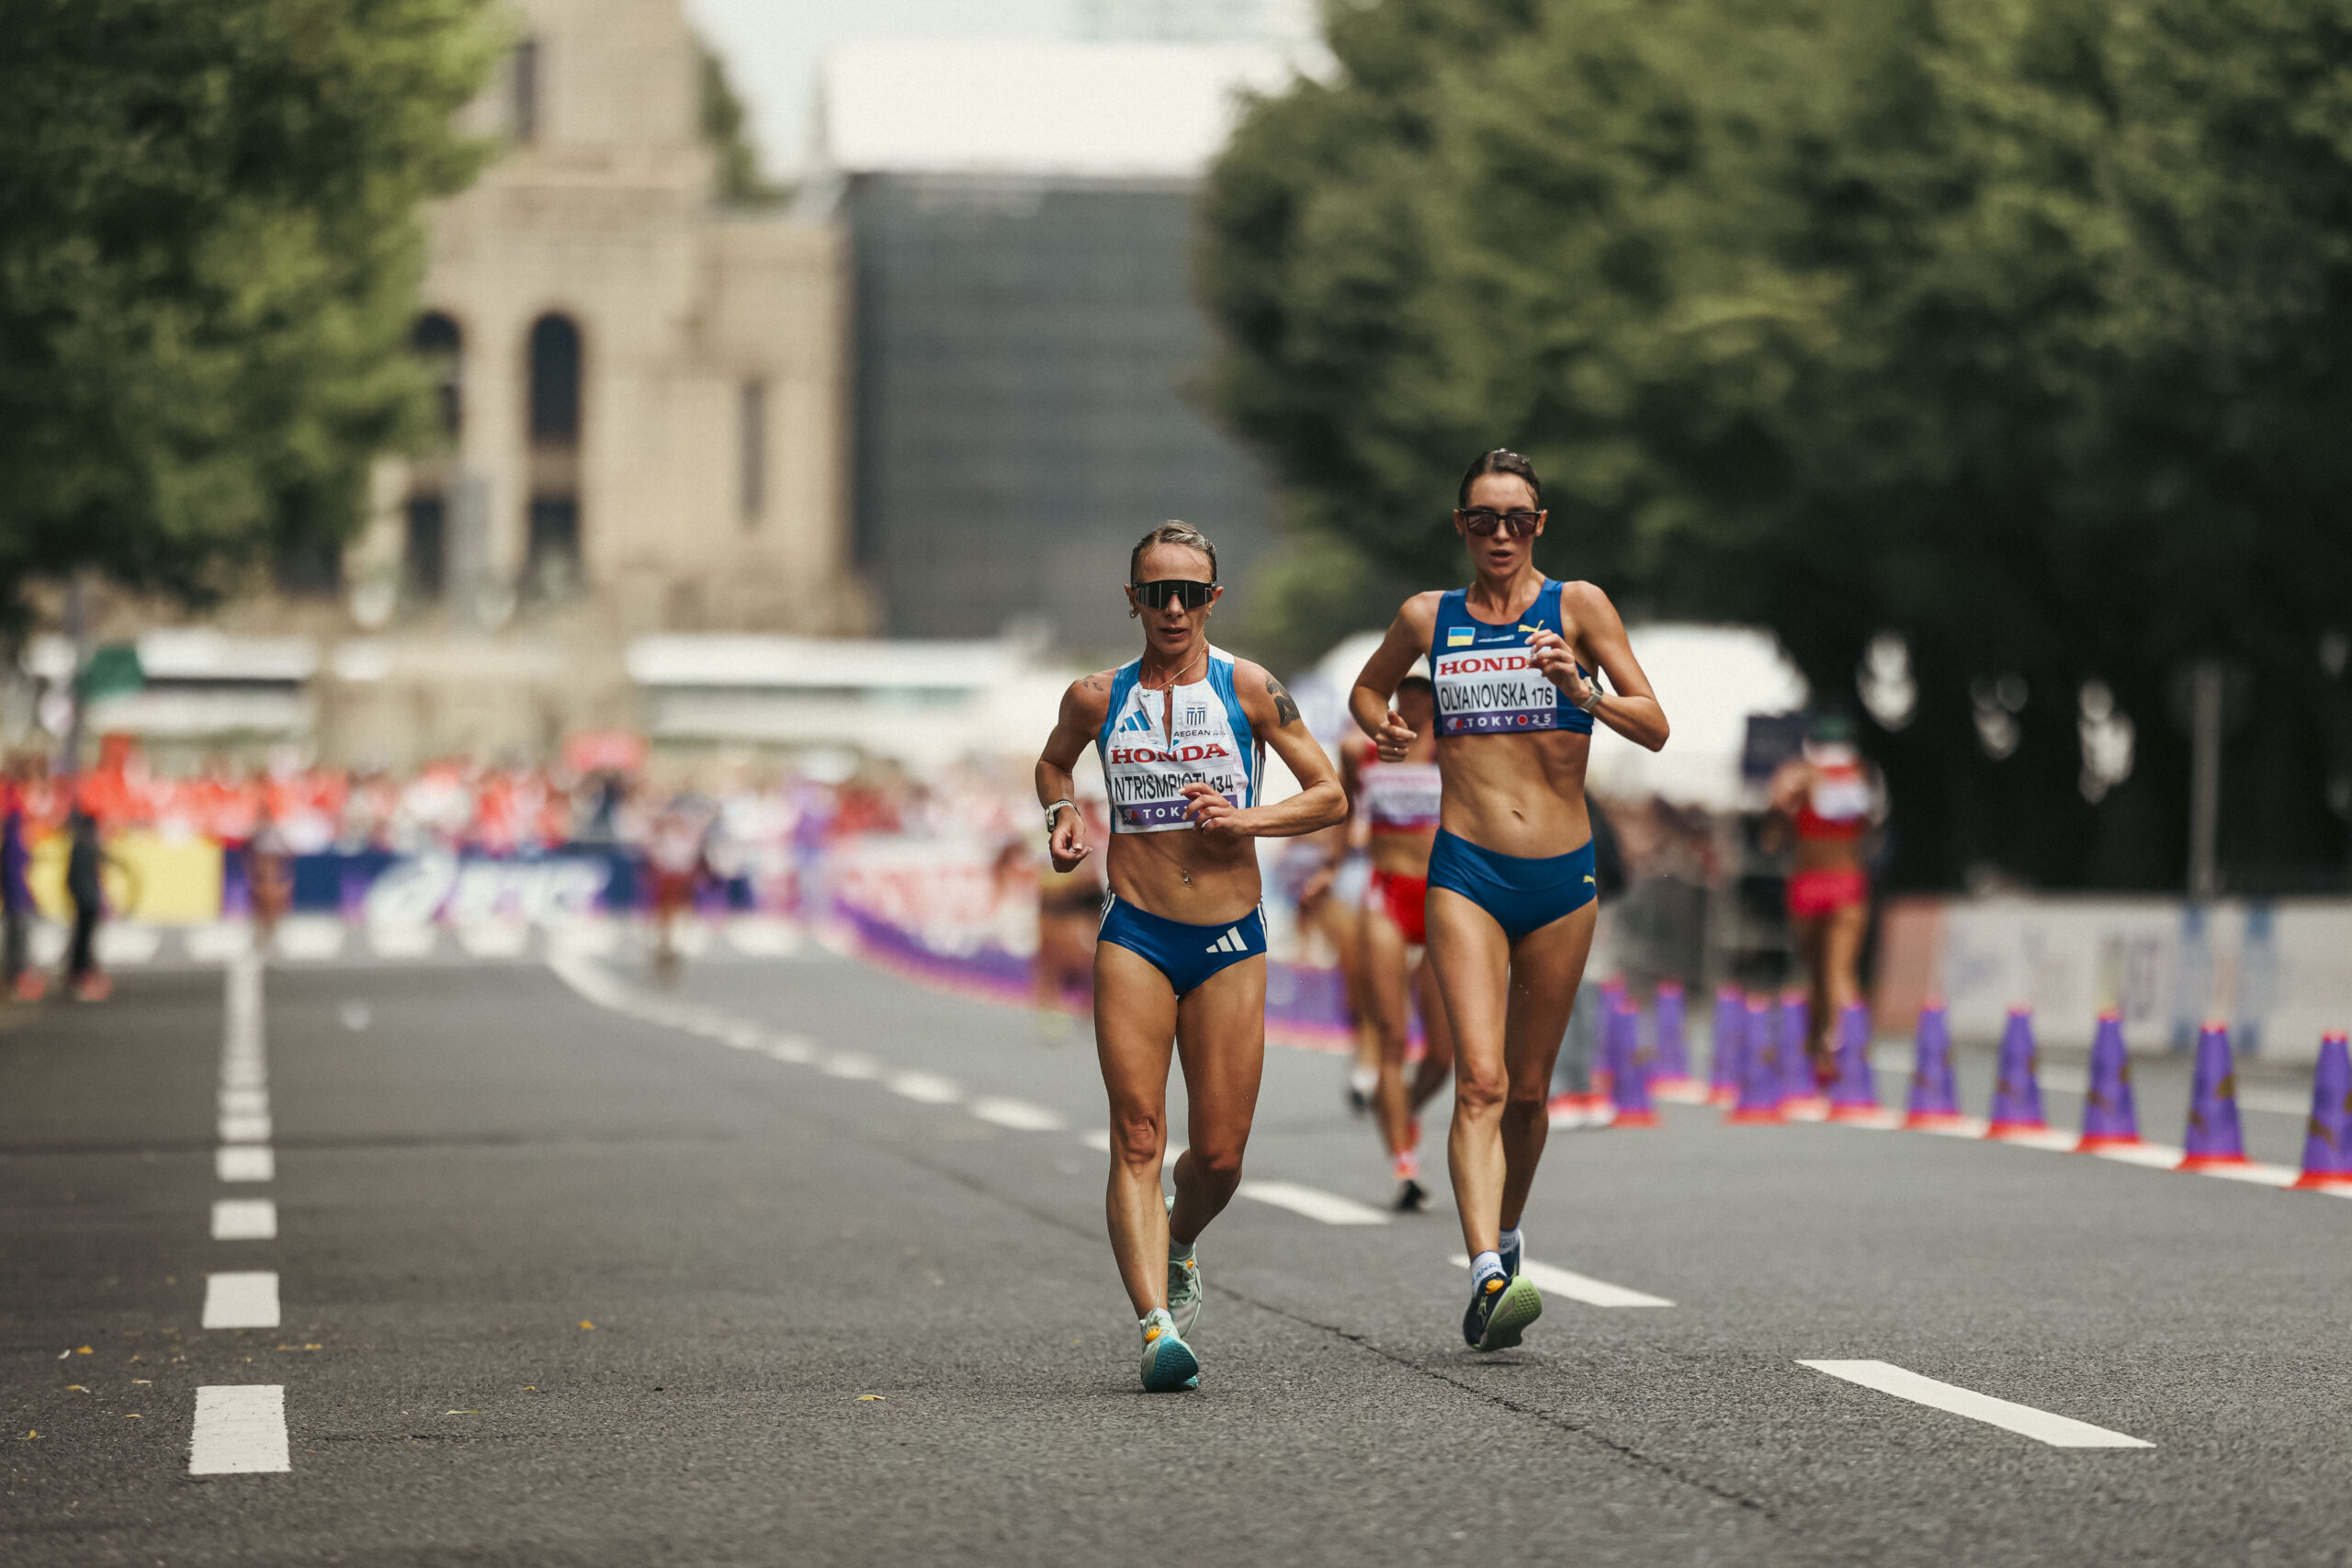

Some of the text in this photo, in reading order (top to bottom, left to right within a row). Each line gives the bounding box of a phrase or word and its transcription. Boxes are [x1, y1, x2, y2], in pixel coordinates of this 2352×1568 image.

[1438, 656, 1539, 676] HOND
[1441, 682, 1553, 711] OLYANOVSKA 176
[1173, 729, 1211, 738] AEGEAN
[1111, 743, 1229, 764] HONDA
[1210, 774, 1234, 794] 134
